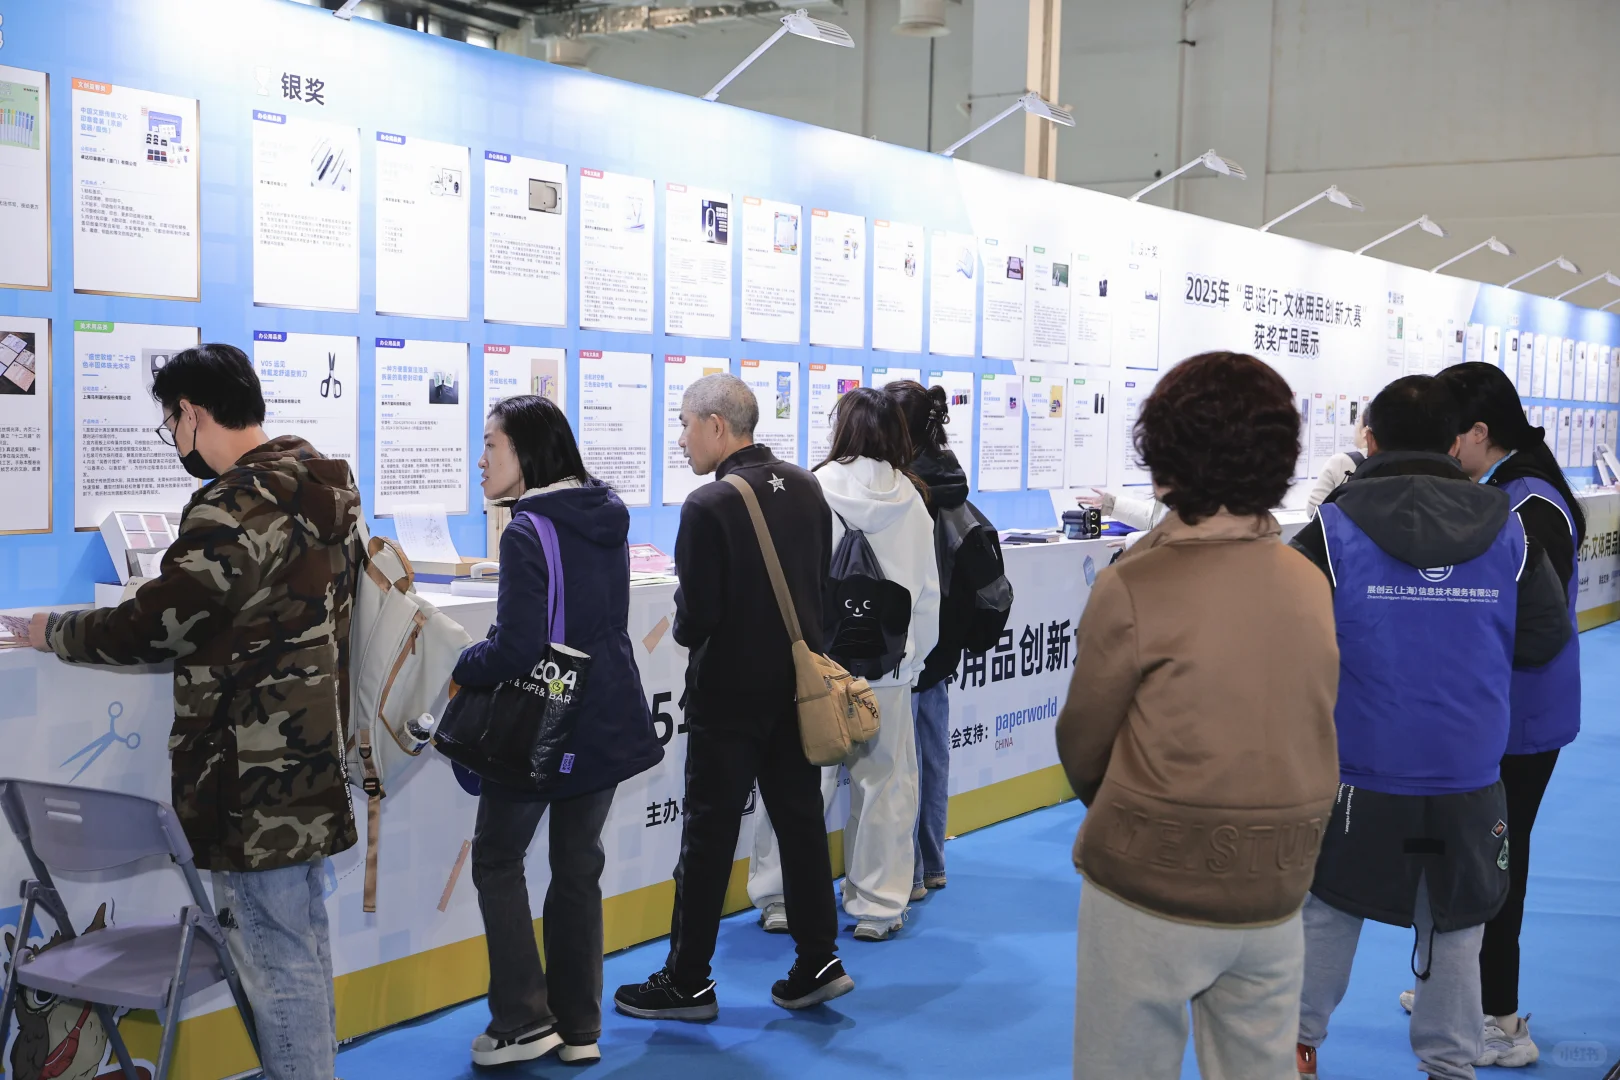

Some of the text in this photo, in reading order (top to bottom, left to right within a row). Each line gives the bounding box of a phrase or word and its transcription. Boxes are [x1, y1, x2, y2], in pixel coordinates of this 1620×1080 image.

[280, 71, 325, 105] 银奖
[258, 332, 282, 340] 办公用品类
[1253, 323, 1320, 356] 获奖产品展示
[1577, 530, 1618, 562] 行·文体用品
[944, 619, 1078, 693] 用品创新
[548, 692, 572, 704] BAR
[995, 696, 1058, 737] paperworld
[949, 723, 988, 750] 会支持：
[994, 737, 1014, 750] CHINA
[646, 795, 686, 828] 主办
